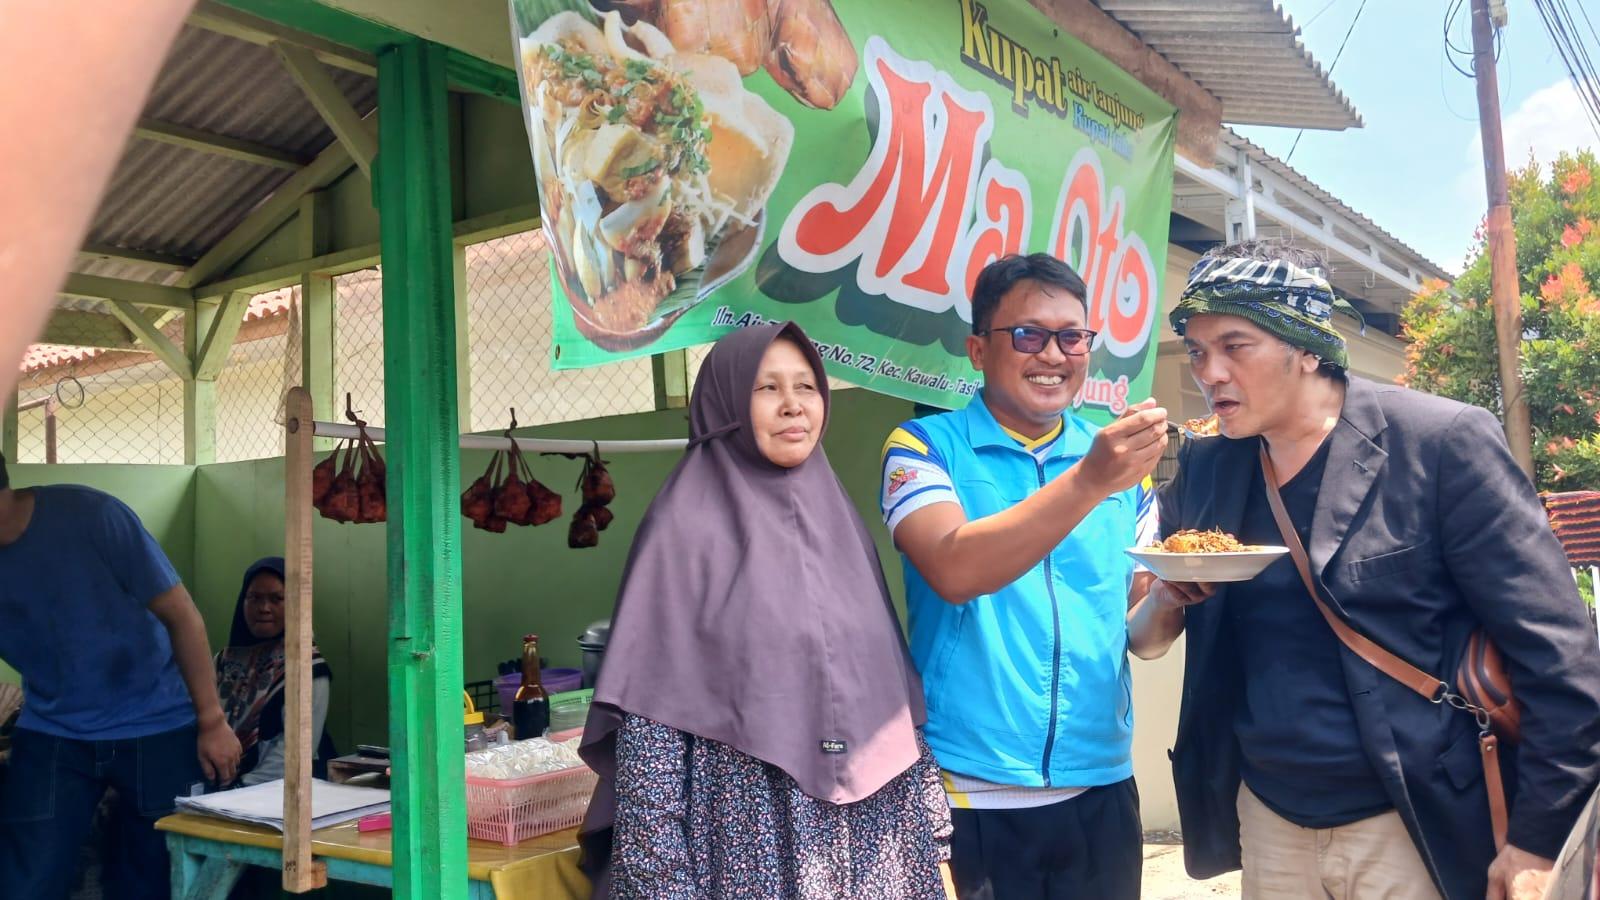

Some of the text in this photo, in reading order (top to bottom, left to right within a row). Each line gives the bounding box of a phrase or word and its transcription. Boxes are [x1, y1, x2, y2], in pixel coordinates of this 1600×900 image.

[961, 0, 1067, 112] Kupat
[1067, 68, 1144, 138] air tanjung
[788, 46, 1153, 348] Ma Oto
[828, 345, 853, 366] No.
[855, 354, 875, 374] 72,
[877, 360, 901, 380] Kec.
[1073, 376, 1128, 414] jung
